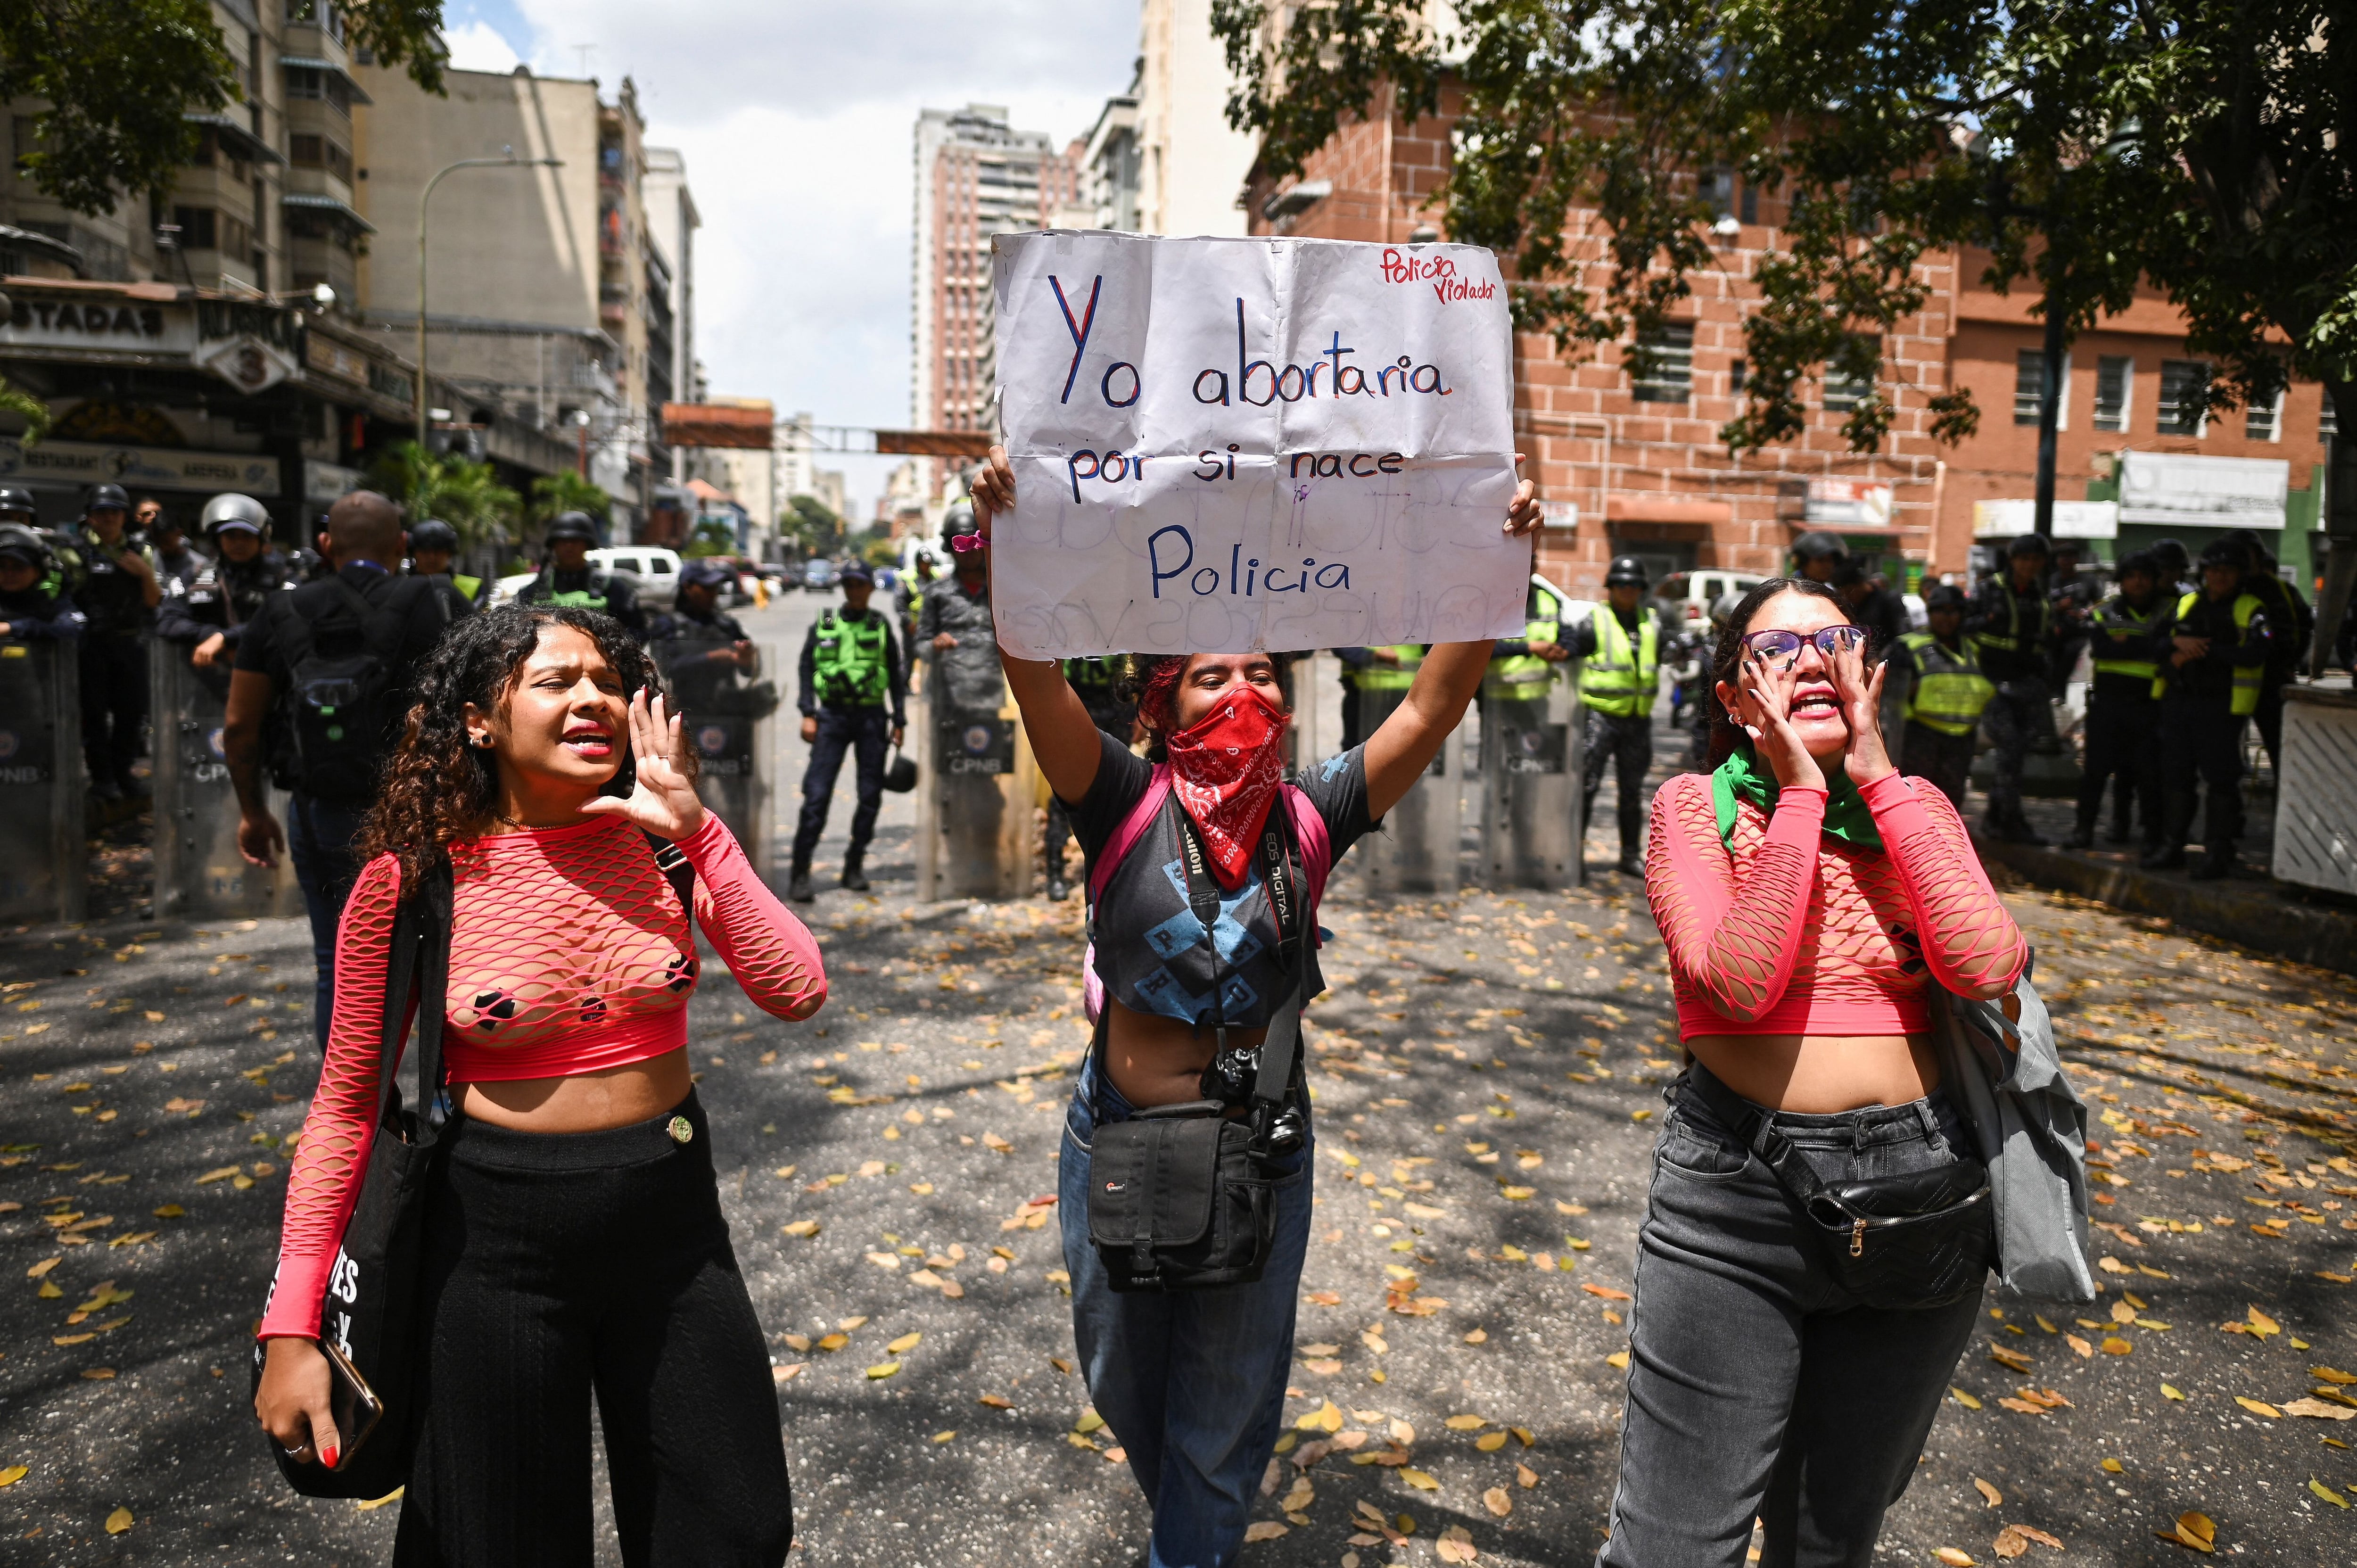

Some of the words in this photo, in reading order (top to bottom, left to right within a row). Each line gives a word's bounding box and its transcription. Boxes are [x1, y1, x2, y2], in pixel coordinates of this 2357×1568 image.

[1380, 248, 1456, 283] Policia
[1048, 274, 1141, 408] Yo
[1192, 297, 1452, 407] abortaria
[1068, 449, 1156, 504] por
[1192, 443, 1241, 481] si
[1290, 451, 1405, 479] nace
[1148, 524, 1350, 599] Policia
[950, 757, 1001, 774] CPNB
[1266, 833, 1279, 861] EOS
[1271, 866, 1290, 924] DIGITAL
